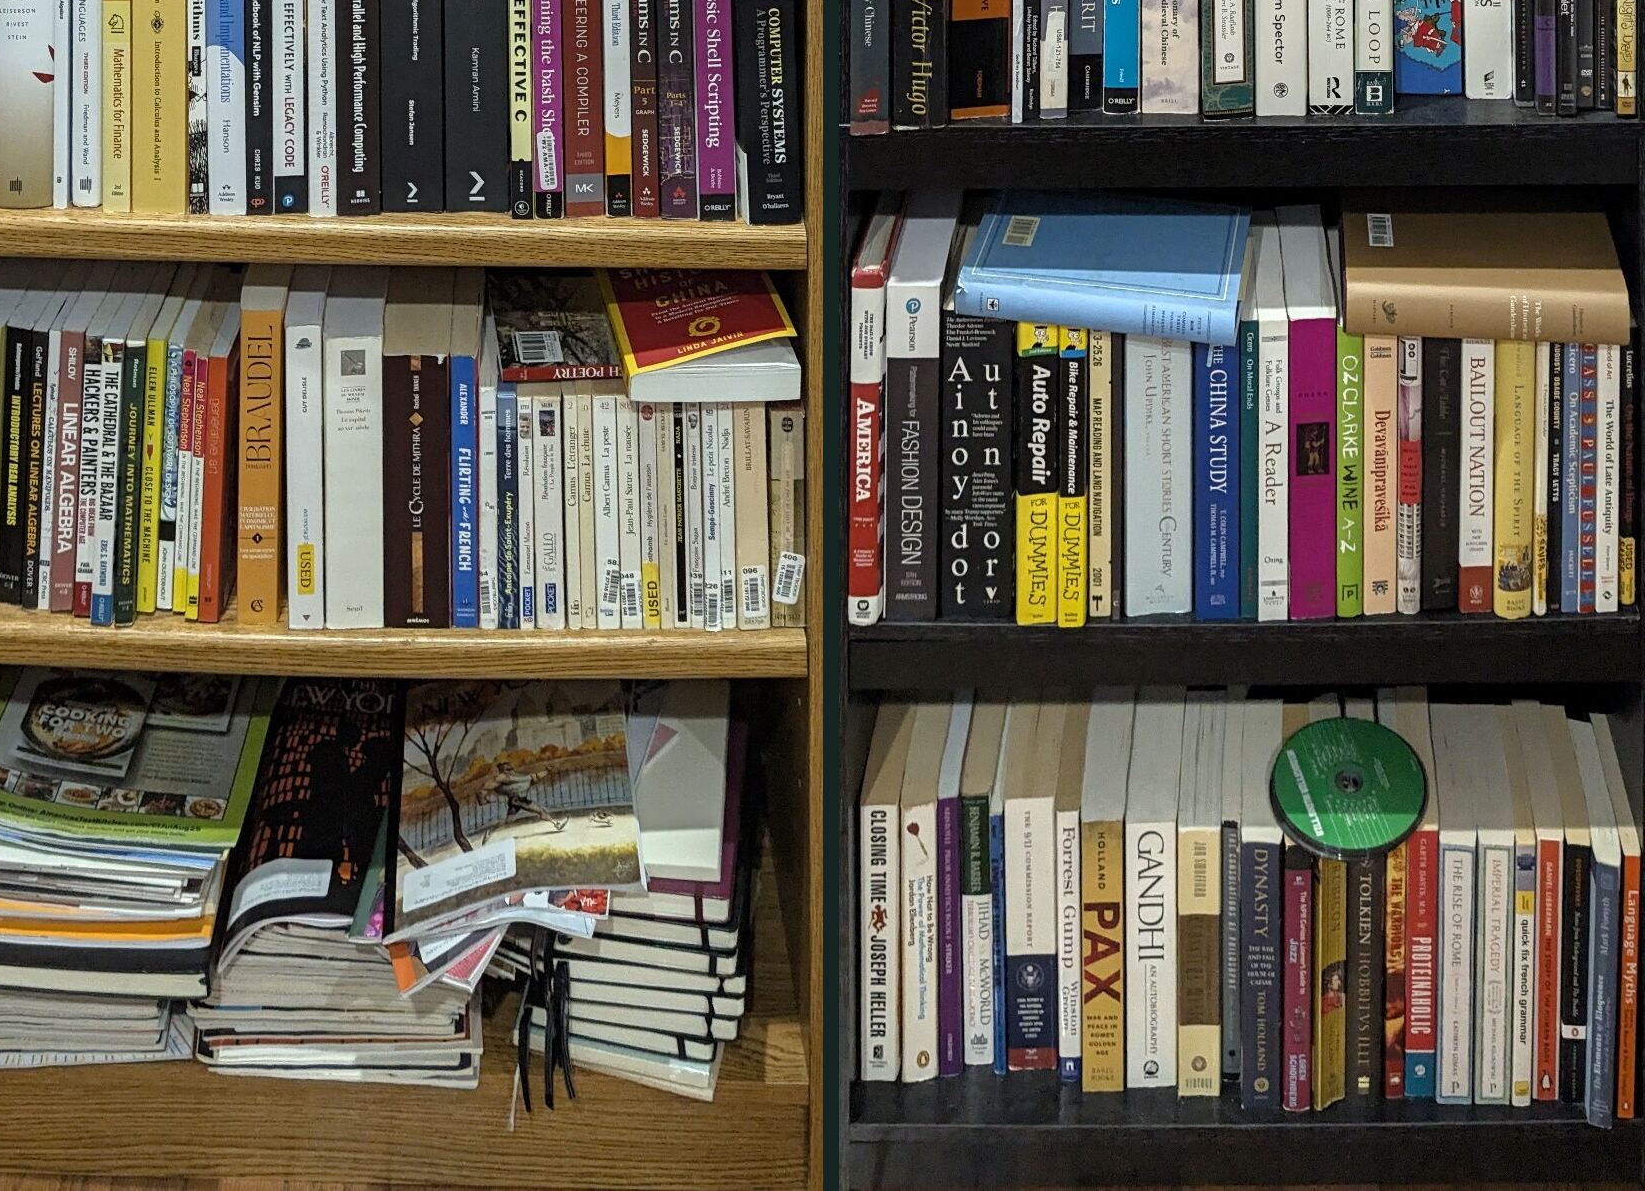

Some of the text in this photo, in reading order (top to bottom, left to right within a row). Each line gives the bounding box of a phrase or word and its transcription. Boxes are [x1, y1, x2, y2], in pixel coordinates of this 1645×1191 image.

[246, 325, 272, 463] BRAUDEL
[1209, 370, 1227, 493] CHINA STUDY
[1469, 357, 1486, 517] BAILOUT NATION
[857, 398, 875, 502] AMERICA
[301, 552, 310, 588] USED
[648, 581, 659, 617] USED
[1138, 831, 1165, 961] GANDHI
[1359, 874, 1372, 945] TOLKIEN
[1411, 937, 1431, 1034] PROTEINAHOLIC
